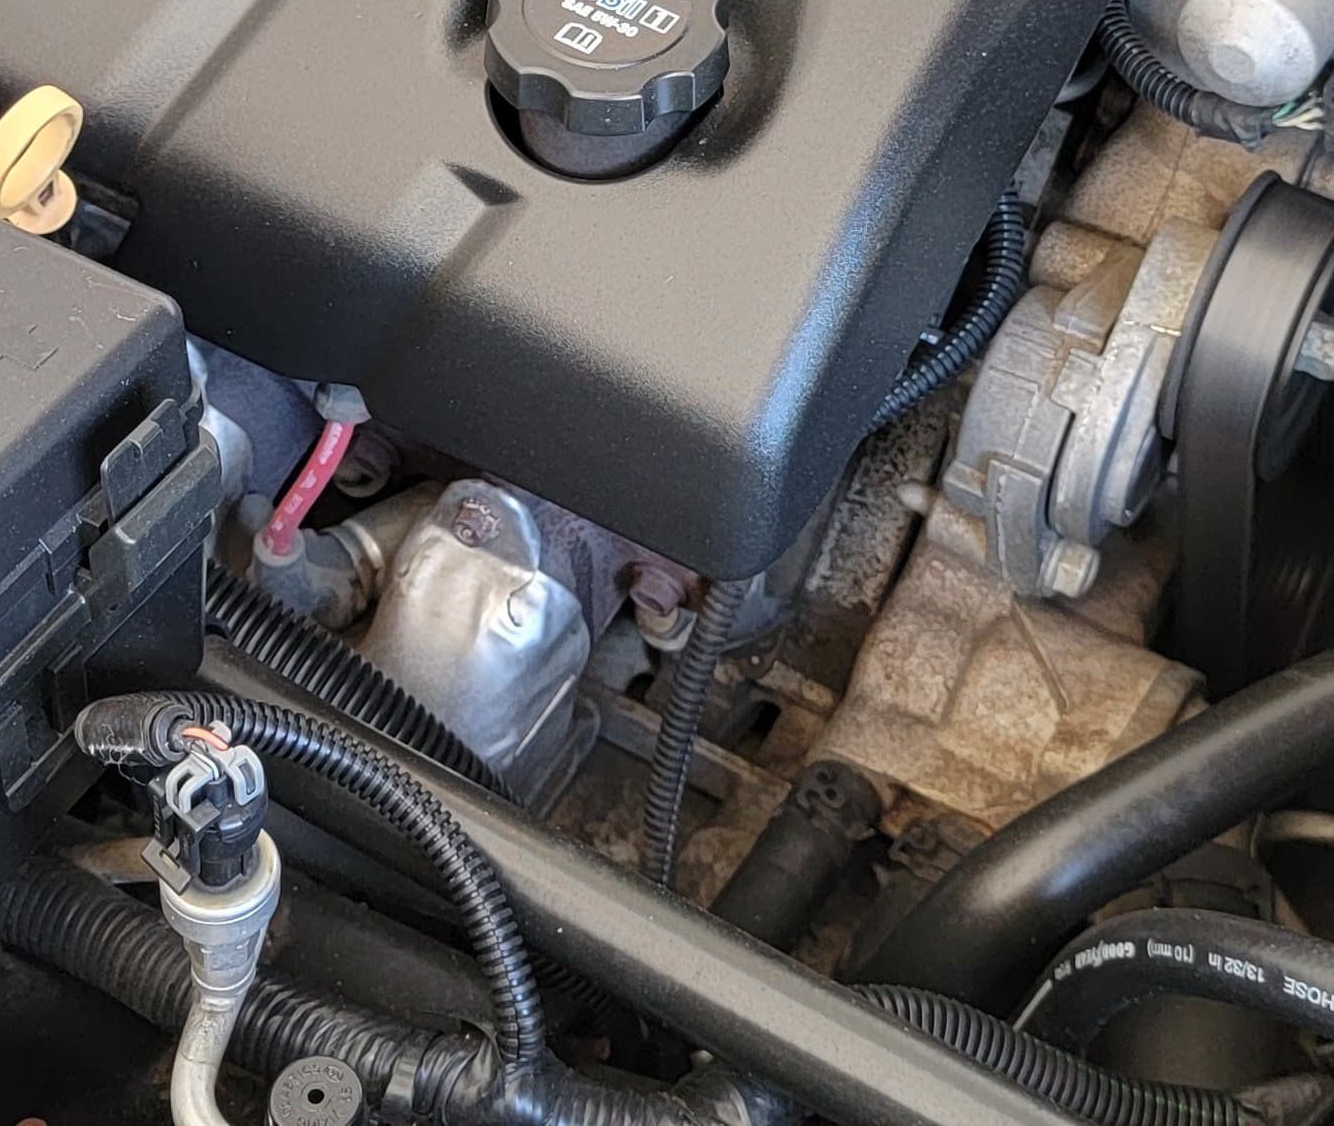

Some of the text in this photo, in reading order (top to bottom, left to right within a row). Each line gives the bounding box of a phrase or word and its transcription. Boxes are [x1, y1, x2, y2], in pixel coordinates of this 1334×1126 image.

[640, 5, 680, 34] 1
[1146, 938, 1173, 958] mm)
[1174, 944, 1196, 964] (10
[1224, 955, 1266, 984] 13/32
